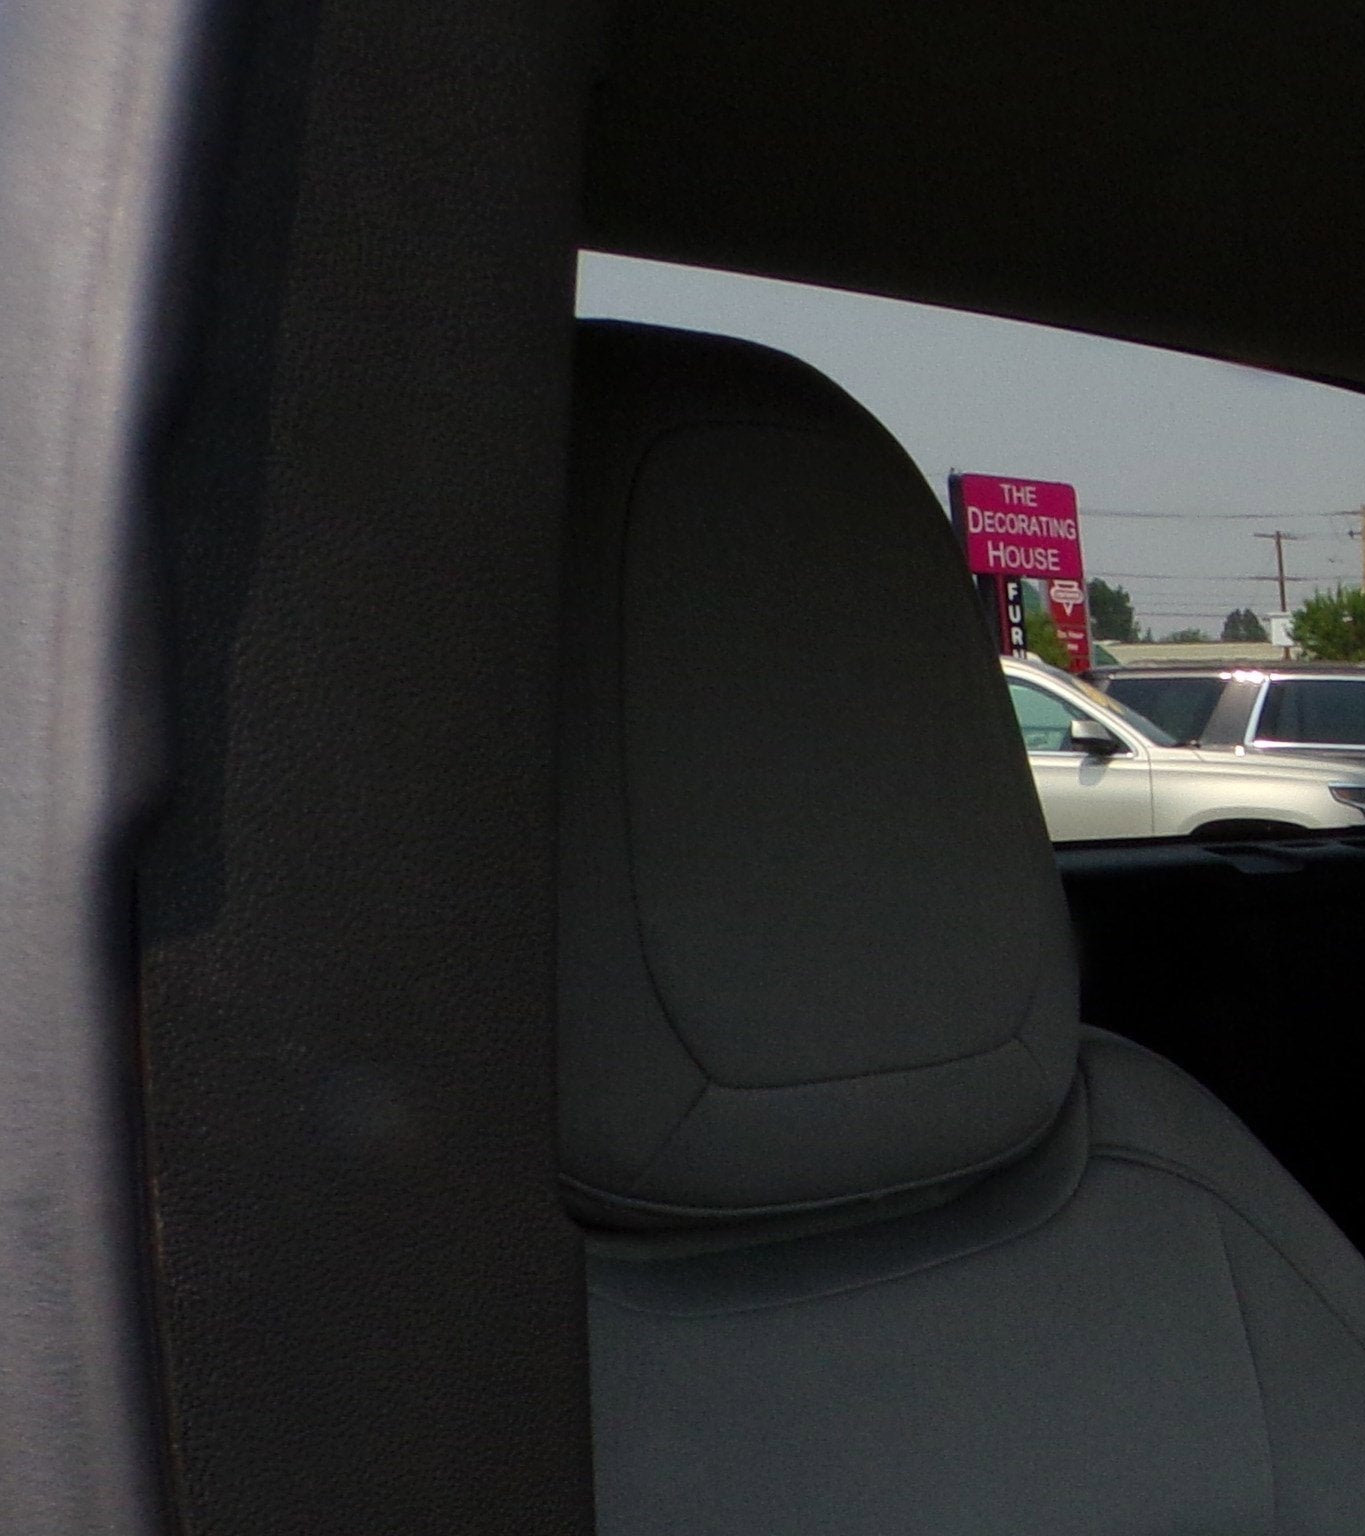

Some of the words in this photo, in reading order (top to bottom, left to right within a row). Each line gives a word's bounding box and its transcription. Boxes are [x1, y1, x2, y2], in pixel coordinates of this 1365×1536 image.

[1000, 484, 1038, 507] THE
[967, 506, 1077, 539] DECORATING
[987, 540, 1061, 571] HOUSE
